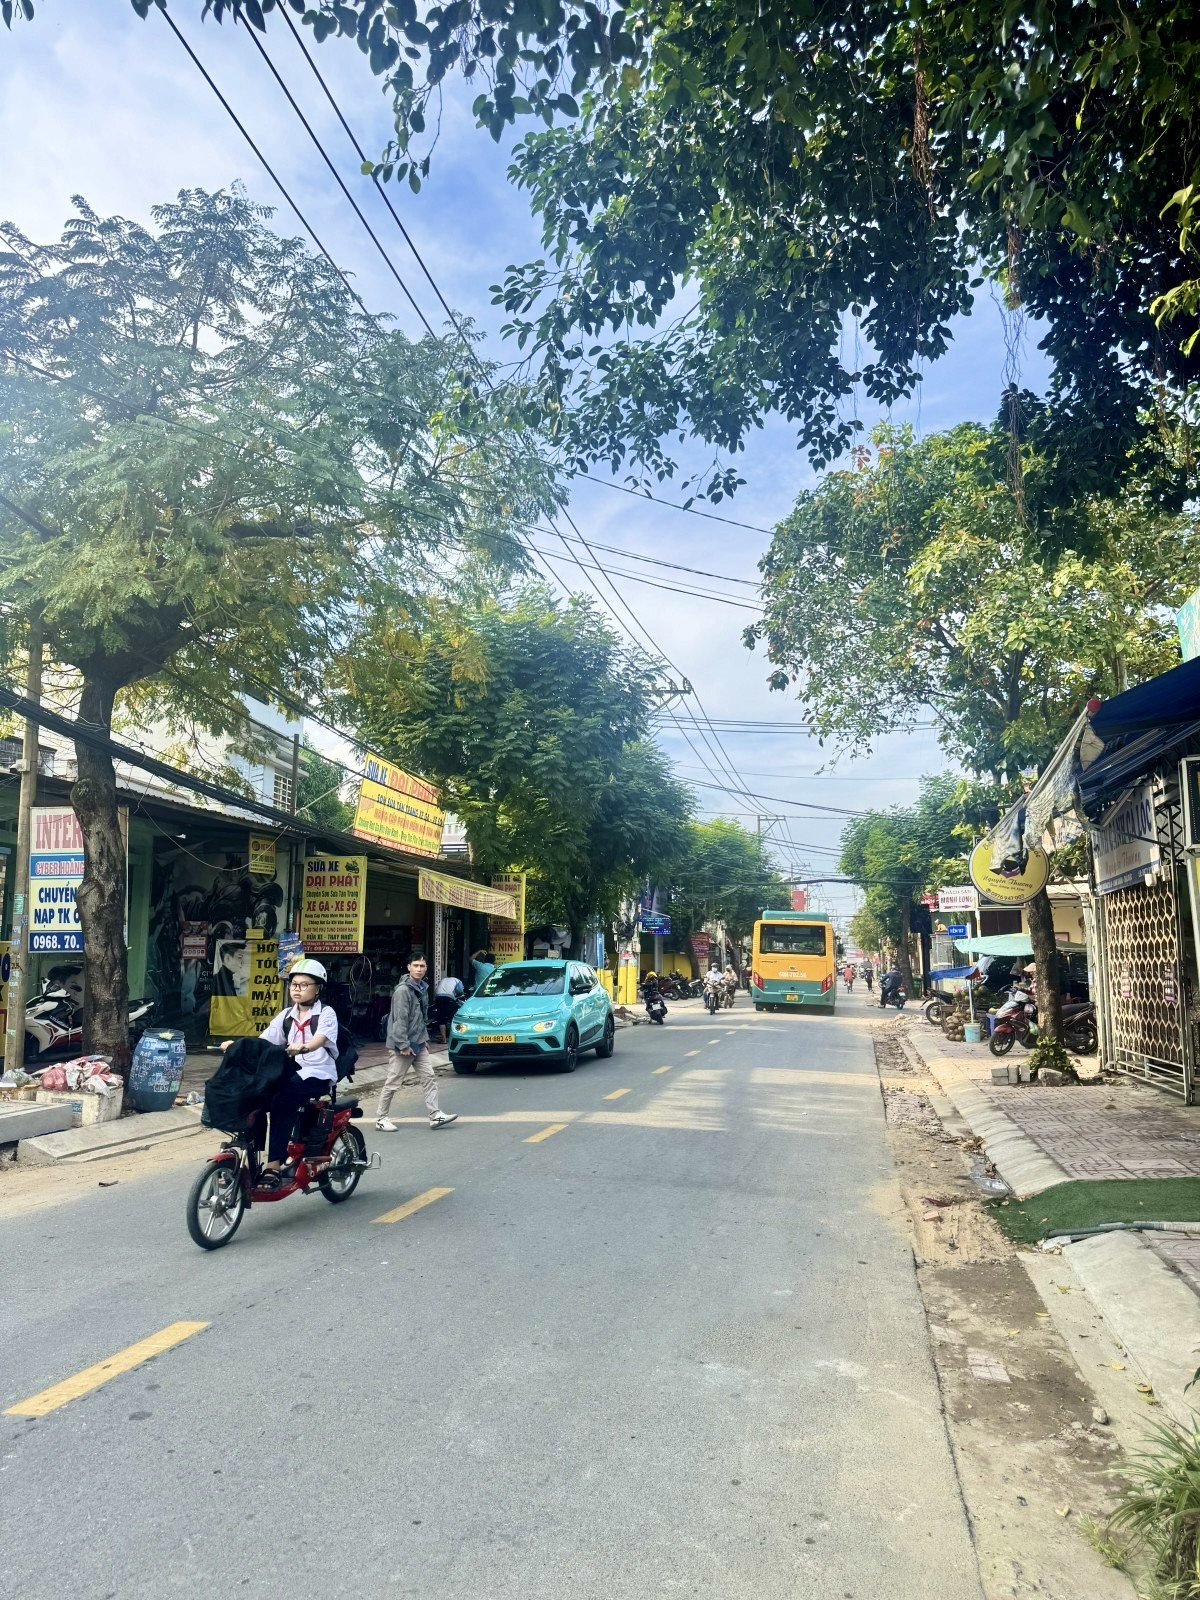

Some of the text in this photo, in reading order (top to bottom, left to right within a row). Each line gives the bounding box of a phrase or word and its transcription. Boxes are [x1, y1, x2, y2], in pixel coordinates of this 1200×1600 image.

[35, 861, 59, 876] CYBER
[307, 858, 339, 872] SỬA XE
[307, 900, 316, 911] XE
[319, 901, 329, 911] GA
[335, 900, 345, 911] XE
[34, 908, 54, 928] NẠP
[58, 908, 70, 923] TK
[33, 935, 80, 949] 0968. 70.
[498, 943, 520, 953] NINH
[254, 975, 280, 987] CẠO
